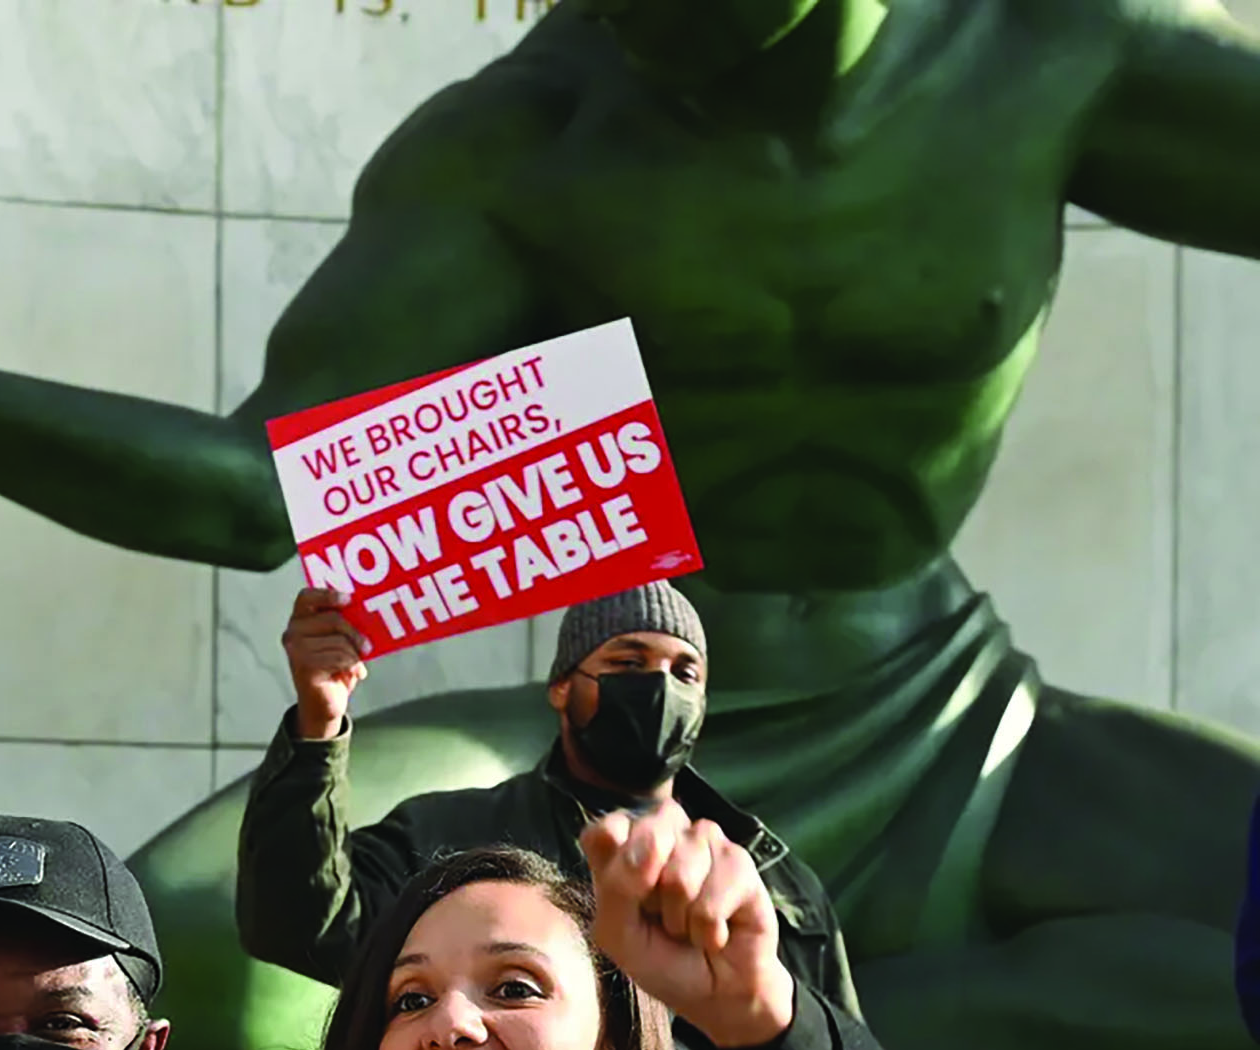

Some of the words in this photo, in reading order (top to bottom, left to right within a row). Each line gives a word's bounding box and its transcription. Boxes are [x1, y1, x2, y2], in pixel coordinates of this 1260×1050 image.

[302, 437, 363, 481] WE
[366, 356, 548, 455] BROUGHT
[323, 466, 401, 516] OUR
[408, 404, 563, 482] CHAIRS,
[303, 507, 442, 596] NOW
[448, 453, 583, 543] GIVE
[576, 421, 662, 490] US
[363, 564, 480, 640] THE
[470, 494, 648, 599] TABLE
